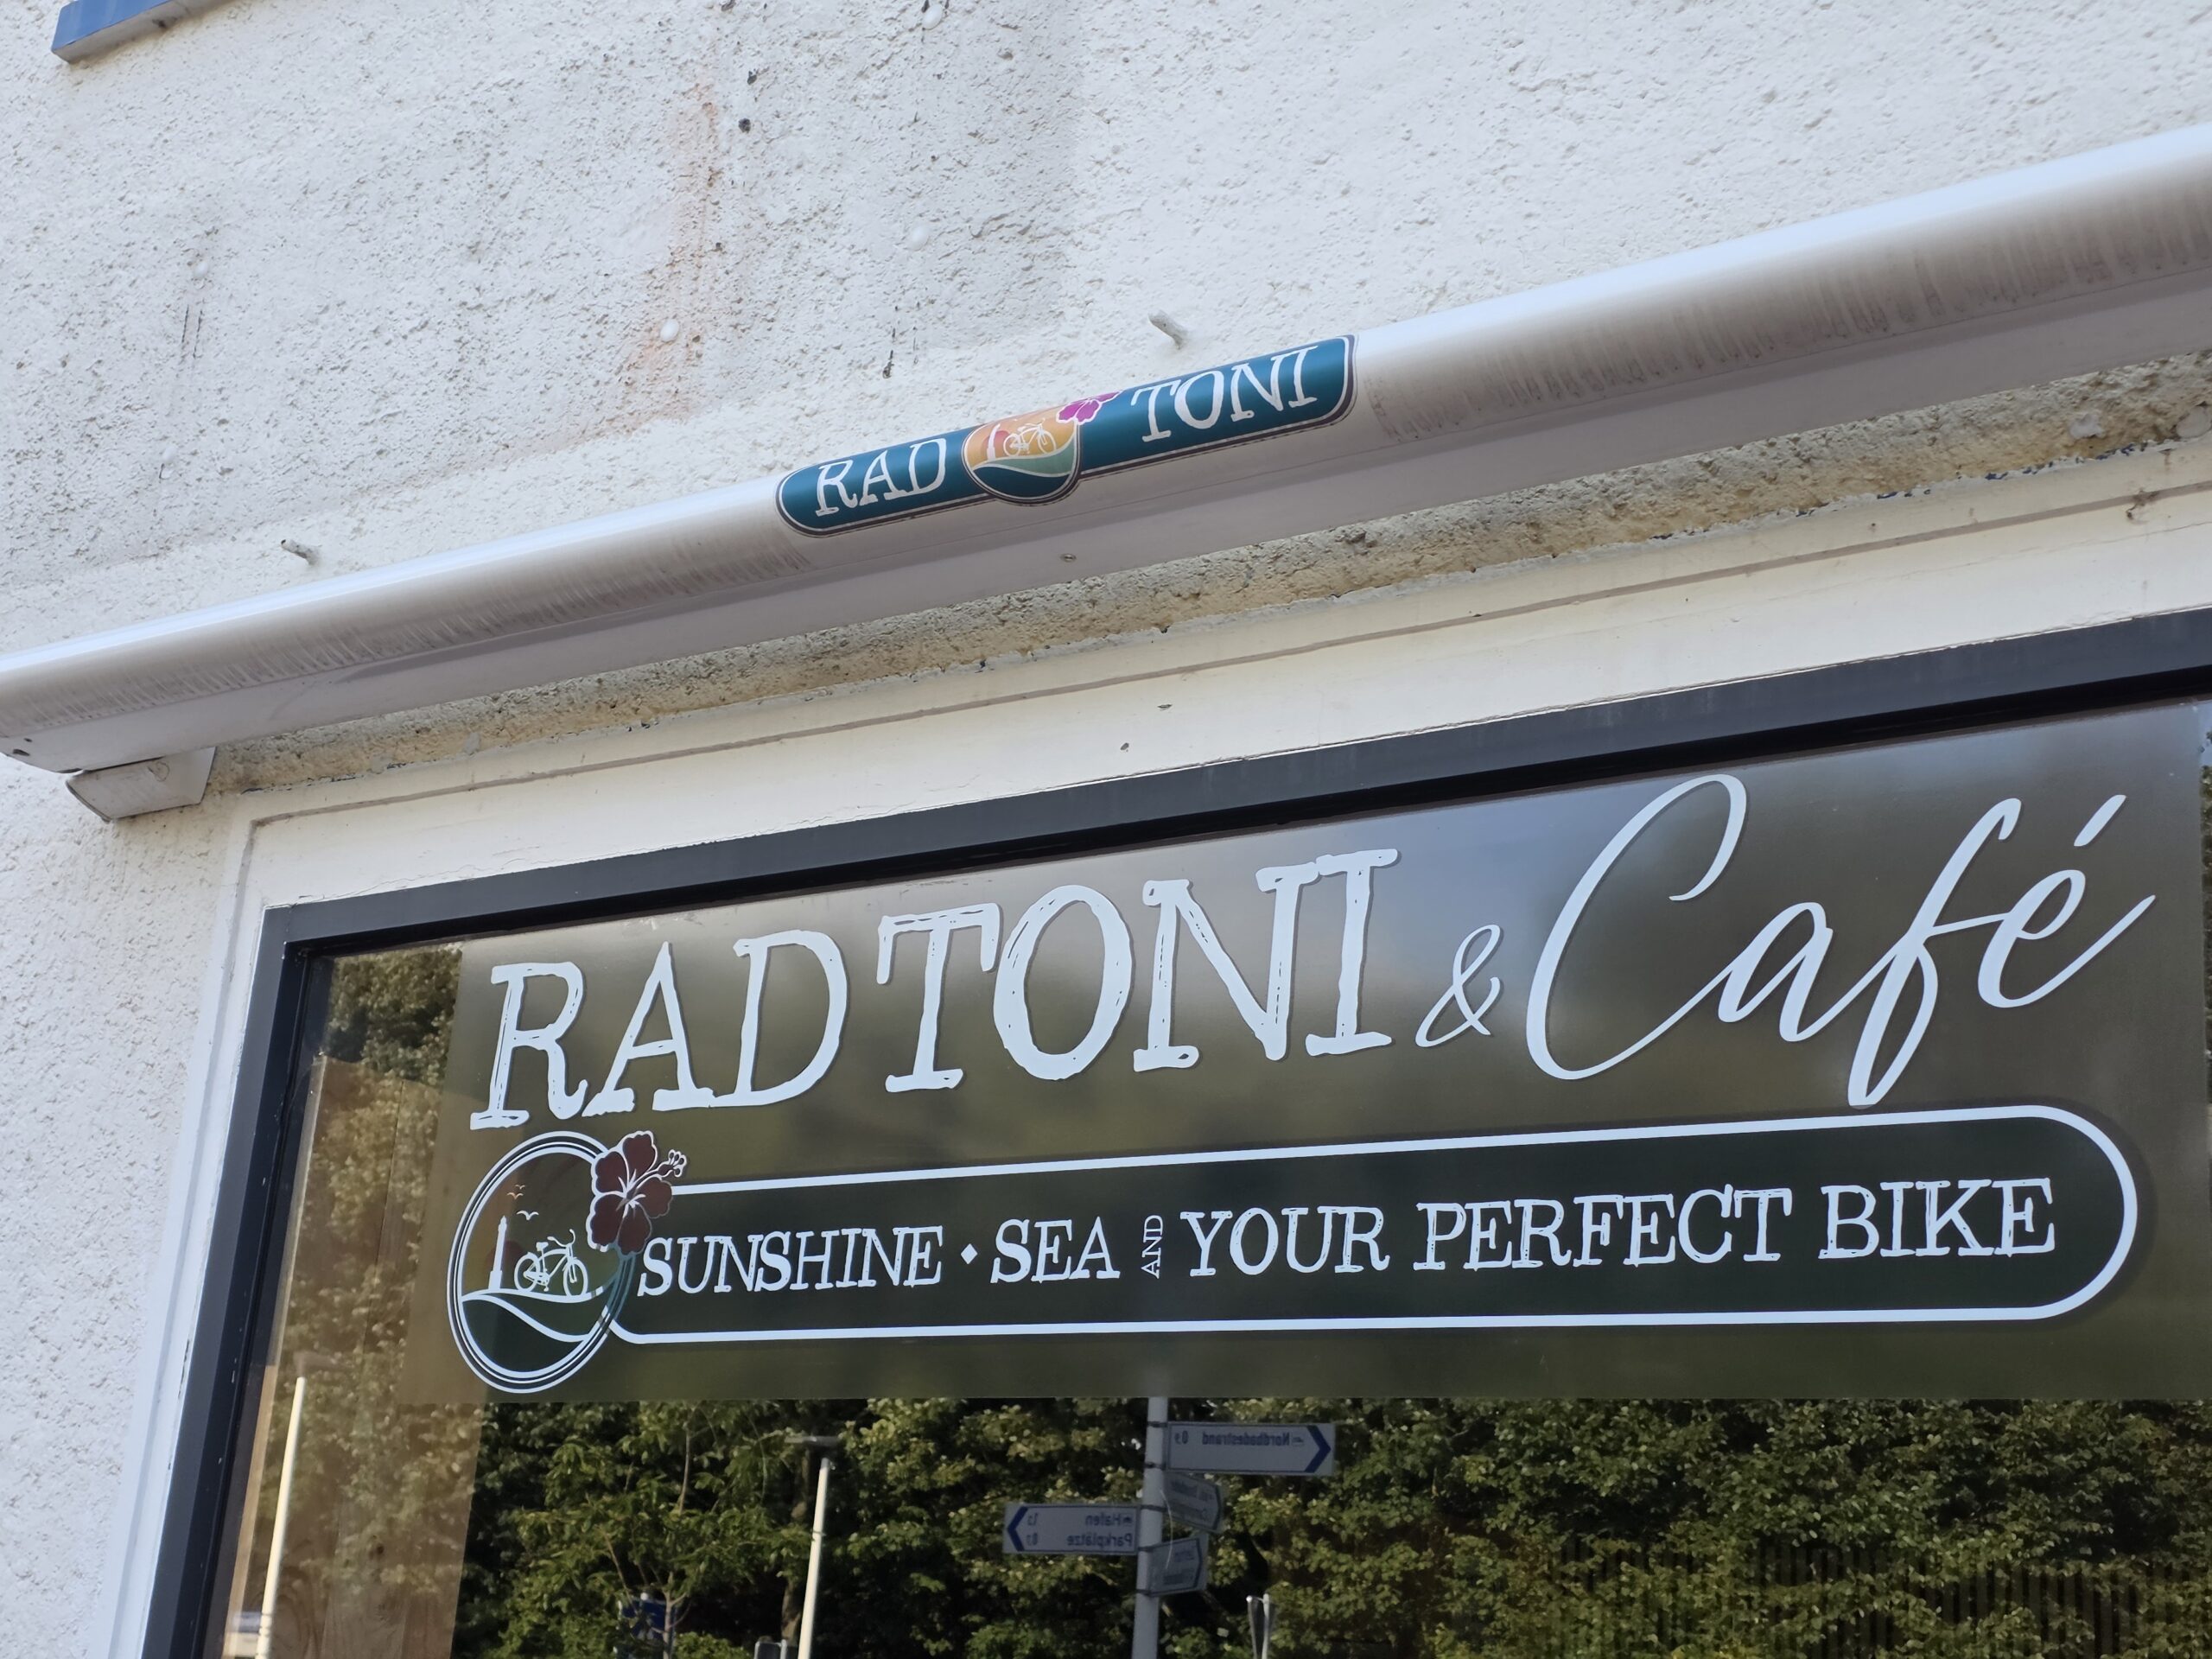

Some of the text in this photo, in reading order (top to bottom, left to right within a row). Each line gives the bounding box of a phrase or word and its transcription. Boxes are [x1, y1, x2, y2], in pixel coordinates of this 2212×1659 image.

[815, 345, 1318, 518] RAD TONI
[1414, 924, 1502, 1047] &
[1525, 773, 2157, 1109] Café
[637, 1177, 2056, 1297] SUNSHINE SEA AND YOUR PERFECT BIKE
